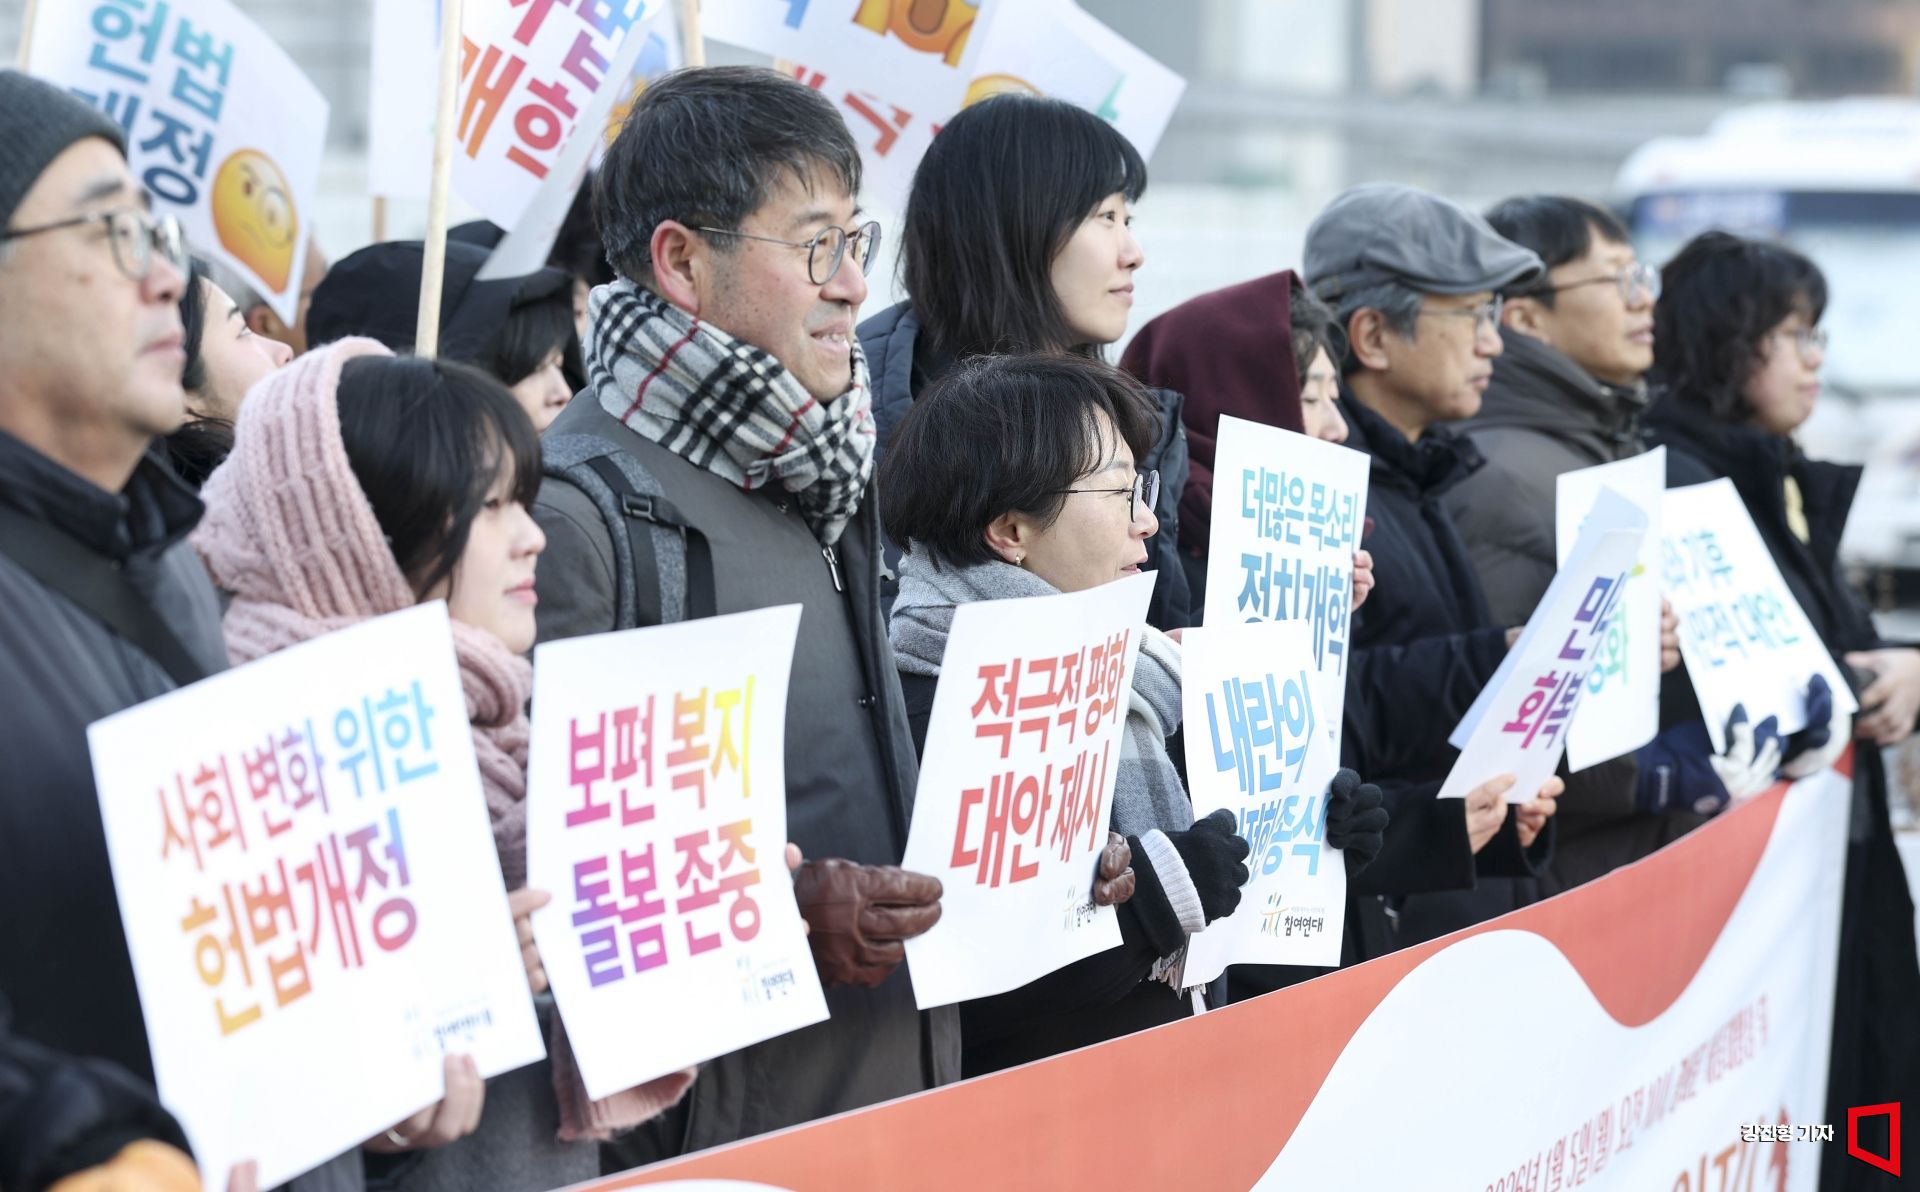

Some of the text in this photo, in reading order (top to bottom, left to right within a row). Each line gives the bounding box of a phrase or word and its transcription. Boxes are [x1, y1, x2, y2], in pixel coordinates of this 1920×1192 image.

[88, 0, 234, 122] 헌법
[1242, 467, 1358, 551] 더많은 목소리
[566, 674, 755, 828] 보편 복지
[971, 628, 1130, 758] 적극적 평화
[1205, 670, 1315, 795] 내란의
[157, 679, 439, 870] 사회 변화 위한
[950, 740, 1110, 888] 대안 제시
[181, 808, 418, 1037] 헌법개정
[572, 819, 761, 988] 돌봄 존중
[1284, 915, 1324, 938] 참여연대
